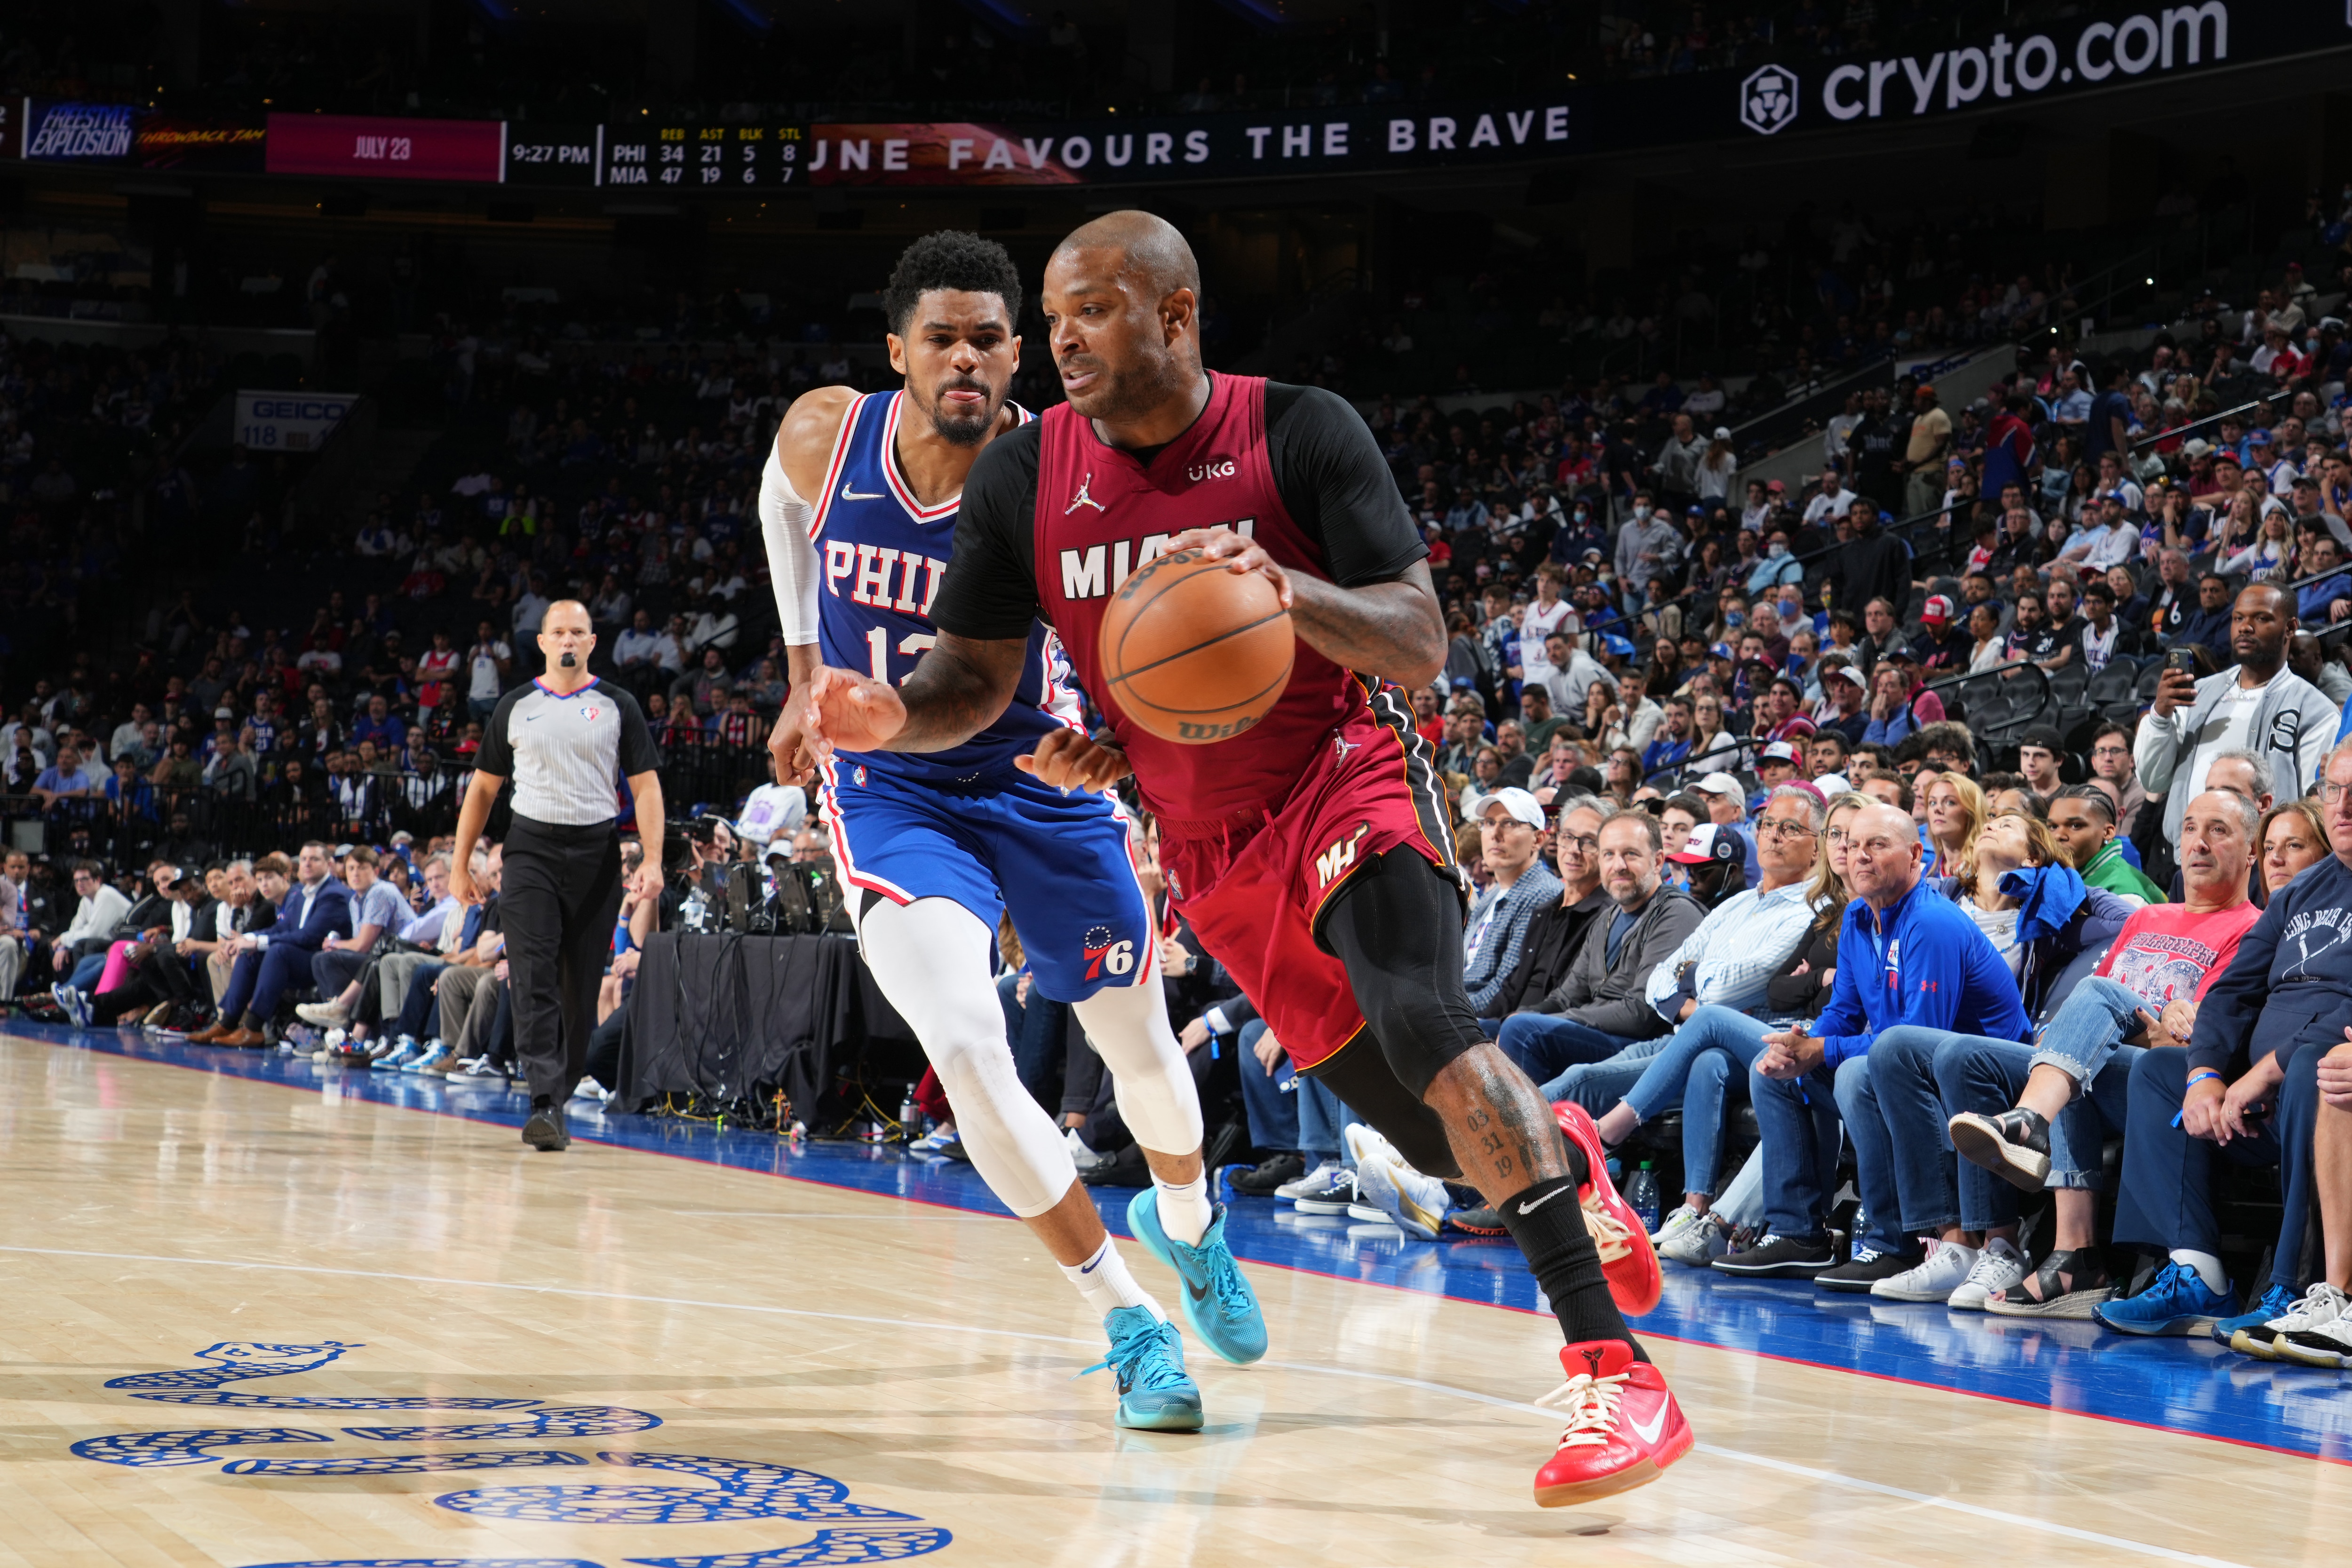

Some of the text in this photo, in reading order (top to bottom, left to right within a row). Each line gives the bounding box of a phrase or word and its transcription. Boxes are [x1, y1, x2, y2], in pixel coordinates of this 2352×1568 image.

[1822, 0, 2228, 121] crypto.com
[41, 104, 133, 129] FREESTYLE
[29, 129, 132, 156] EXPLOSION
[135, 128, 266, 145] THROWBACK JAM
[660, 127, 802, 141] REB AST BLK STL
[948, 130, 1210, 171] FAVOURS
[1245, 122, 1350, 159] THE
[1387, 105, 1571, 153] BRAVE
[353, 135, 412, 160] JULY 23
[513, 143, 590, 164] 9:27 PM
[613, 144, 796, 163] PHI 34 21 5 8
[610, 166, 795, 184] MIA 47 19 6 7
[253, 401, 345, 420] GEICO
[243, 425, 277, 445] 118
[1083, 940, 1134, 982] 76
[1466, 1109, 1488, 1132] 03
[1480, 1132, 1503, 1156] 31
[1495, 1156, 1513, 1179] 19
